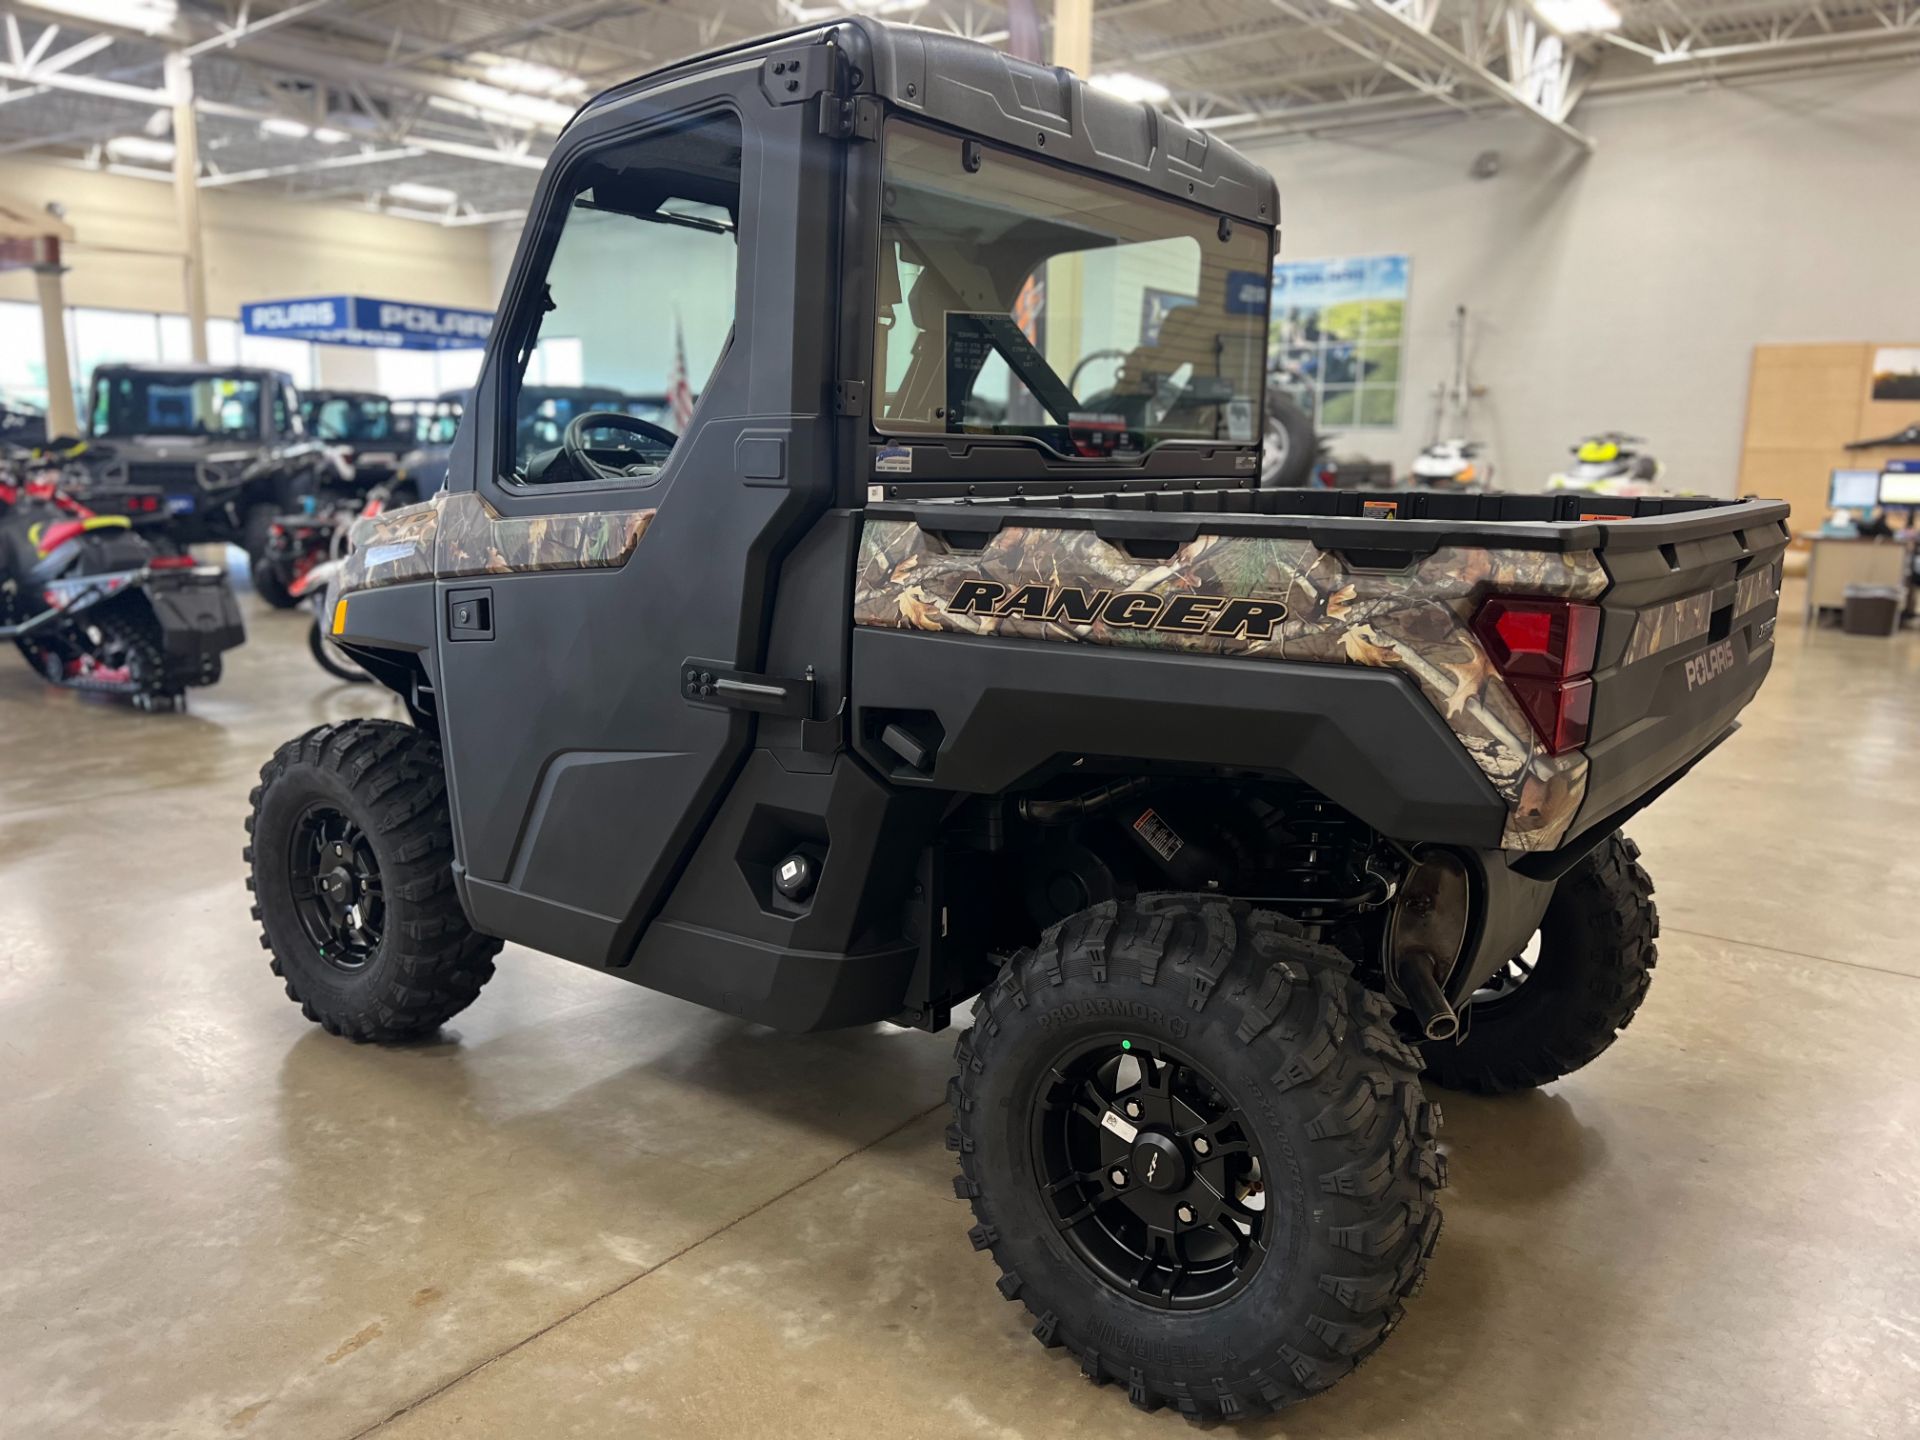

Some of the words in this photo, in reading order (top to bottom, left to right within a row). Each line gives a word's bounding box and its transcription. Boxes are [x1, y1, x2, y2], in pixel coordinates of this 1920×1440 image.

[252, 301, 336, 330] POLARIS
[946, 578, 1290, 641] RANGER
[1684, 640, 1734, 693] POLARIS
[1037, 1002, 1080, 1029] PRO
[1083, 998, 1166, 1026] ARMOR
